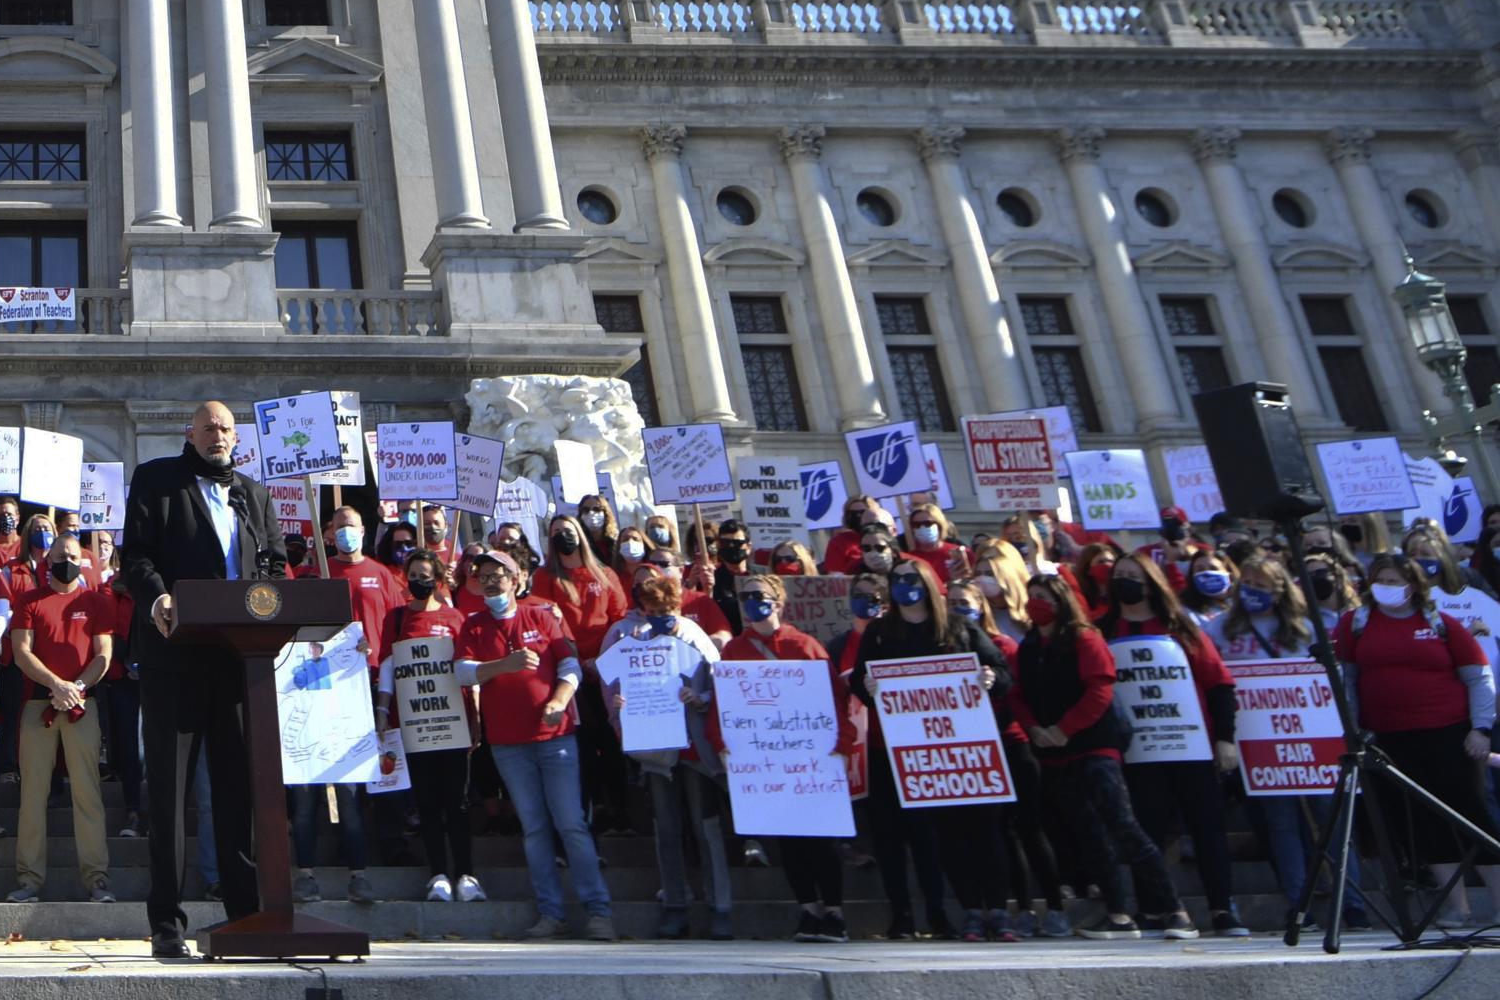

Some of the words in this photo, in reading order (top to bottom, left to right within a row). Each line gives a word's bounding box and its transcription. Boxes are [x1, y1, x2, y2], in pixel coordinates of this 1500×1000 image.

[20, 289, 50, 301] Scranton
[0, 304, 33, 320] Federation
[35, 303, 41, 316] of
[43, 303, 72, 318] Teachers
[257, 402, 280, 435] F
[287, 418, 296, 428] IS
[301, 416, 316, 428] FOR
[266, 455, 295, 476] Fair
[296, 451, 344, 473] Funding
[378, 450, 447, 469] $39,000,000
[466, 453, 491, 464] WORDS
[867, 431, 914, 482] aft
[974, 441, 997, 470] ON
[997, 441, 1050, 470] STRIKE
[760, 465, 775, 476] NO
[740, 478, 799, 490] CONTRACT
[978, 475, 1012, 485] SCRANTON
[763, 493, 780, 504] NO
[996, 489, 1004, 498] OF
[1006, 488, 1041, 498] TEACHERS
[1082, 482, 1137, 501] HANDS
[280, 503, 297, 517] FOR
[756, 506, 791, 518] WORK
[411, 645, 429, 659] NO
[620, 646, 644, 654] We're
[1130, 648, 1153, 663] NO
[629, 654, 666, 669] RED
[394, 660, 455, 681] CONTRACT
[714, 665, 748, 680] We're
[1116, 666, 1187, 682] ONTRACT
[417, 679, 436, 694] NO
[740, 682, 781, 699] RED
[1139, 685, 1162, 699] NO
[1310, 680, 1333, 708] UP
[409, 695, 450, 713] WORK
[880, 686, 959, 714] STANDING
[959, 679, 982, 709] UP
[1131, 703, 1181, 719] WORK
[405, 718, 429, 726] SCRANTON
[431, 715, 461, 723] FEDERATION
[723, 711, 757, 730] Even
[764, 713, 834, 732] substitute
[922, 717, 956, 739] FOR
[1270, 714, 1304, 734] FOR
[749, 732, 815, 750] teachers
[901, 745, 993, 773] HEALTHY
[1275, 742, 1316, 763] FAIR
[741, 783, 758, 794] in
[764, 783, 785, 793] our
[793, 773, 845, 793] district
[905, 770, 1005, 798] SCHOOLS
[1251, 764, 1341, 787] CONTRACT
